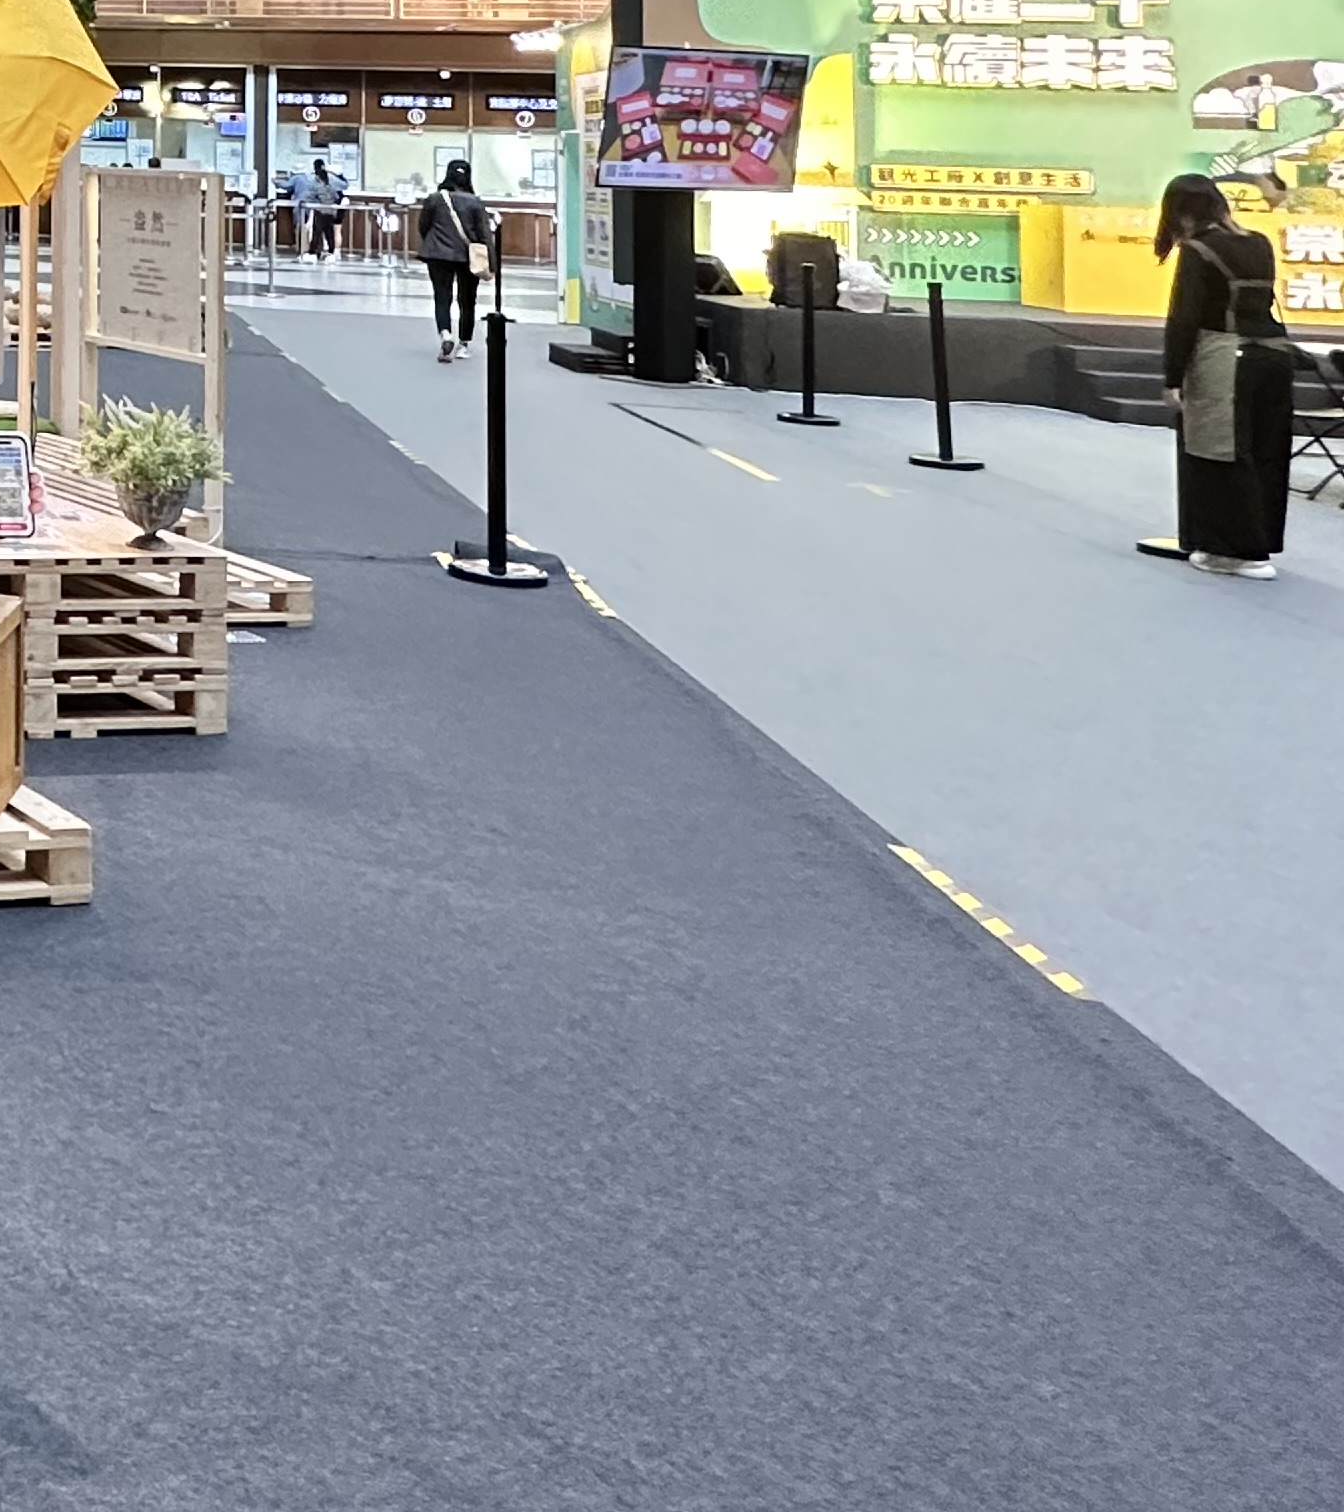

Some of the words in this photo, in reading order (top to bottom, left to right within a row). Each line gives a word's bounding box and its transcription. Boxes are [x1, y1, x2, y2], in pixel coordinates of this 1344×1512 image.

[868, 32, 1178, 91] 永續未來
[868, 254, 1022, 284] Annivers
